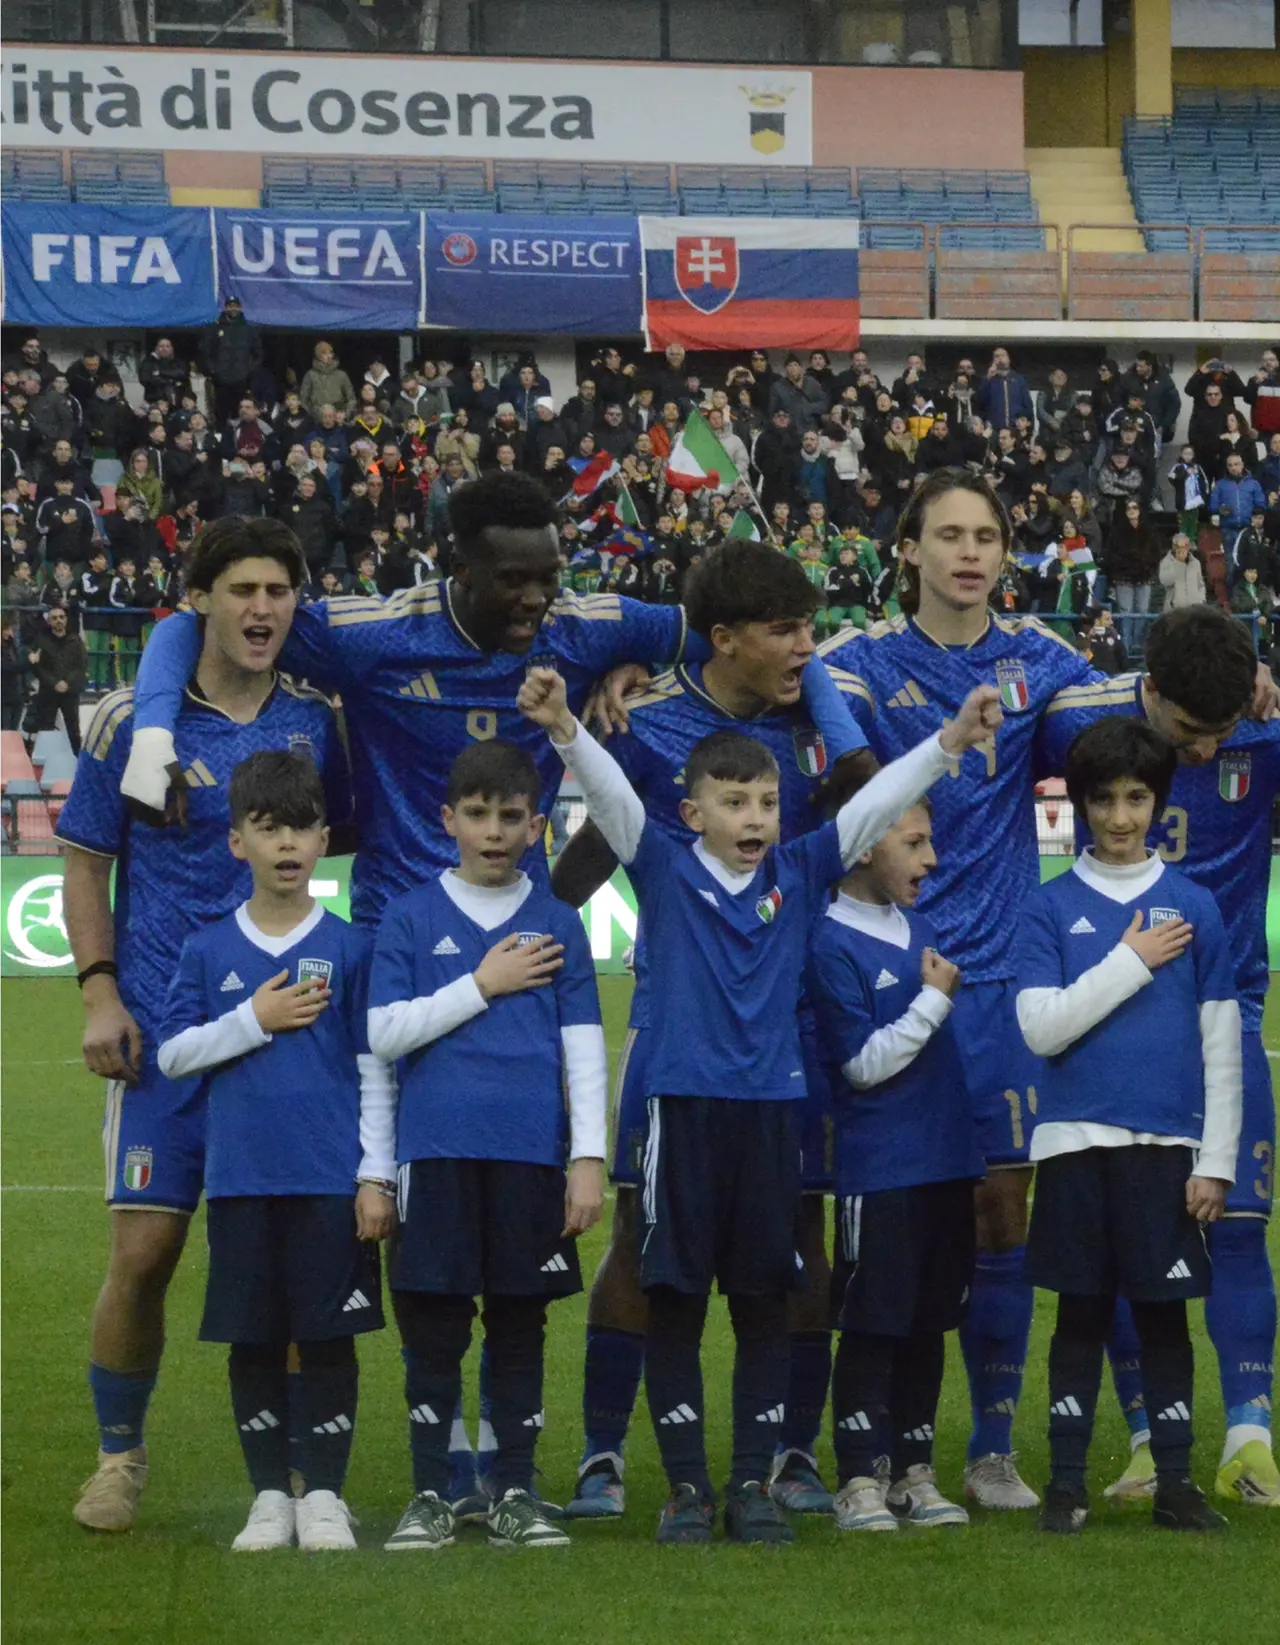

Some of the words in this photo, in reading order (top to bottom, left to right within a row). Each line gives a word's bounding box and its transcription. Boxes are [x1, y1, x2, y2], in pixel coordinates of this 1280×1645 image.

[0, 62, 142, 135] ittà
[160, 67, 231, 130] di
[251, 69, 595, 140] Cosenza
[31, 233, 181, 284] FIFA
[231, 223, 407, 277] UEFA
[490, 238, 630, 268] RESPECT
[1158, 806, 1188, 861] 3
[301, 962, 329, 974] ITALIA
